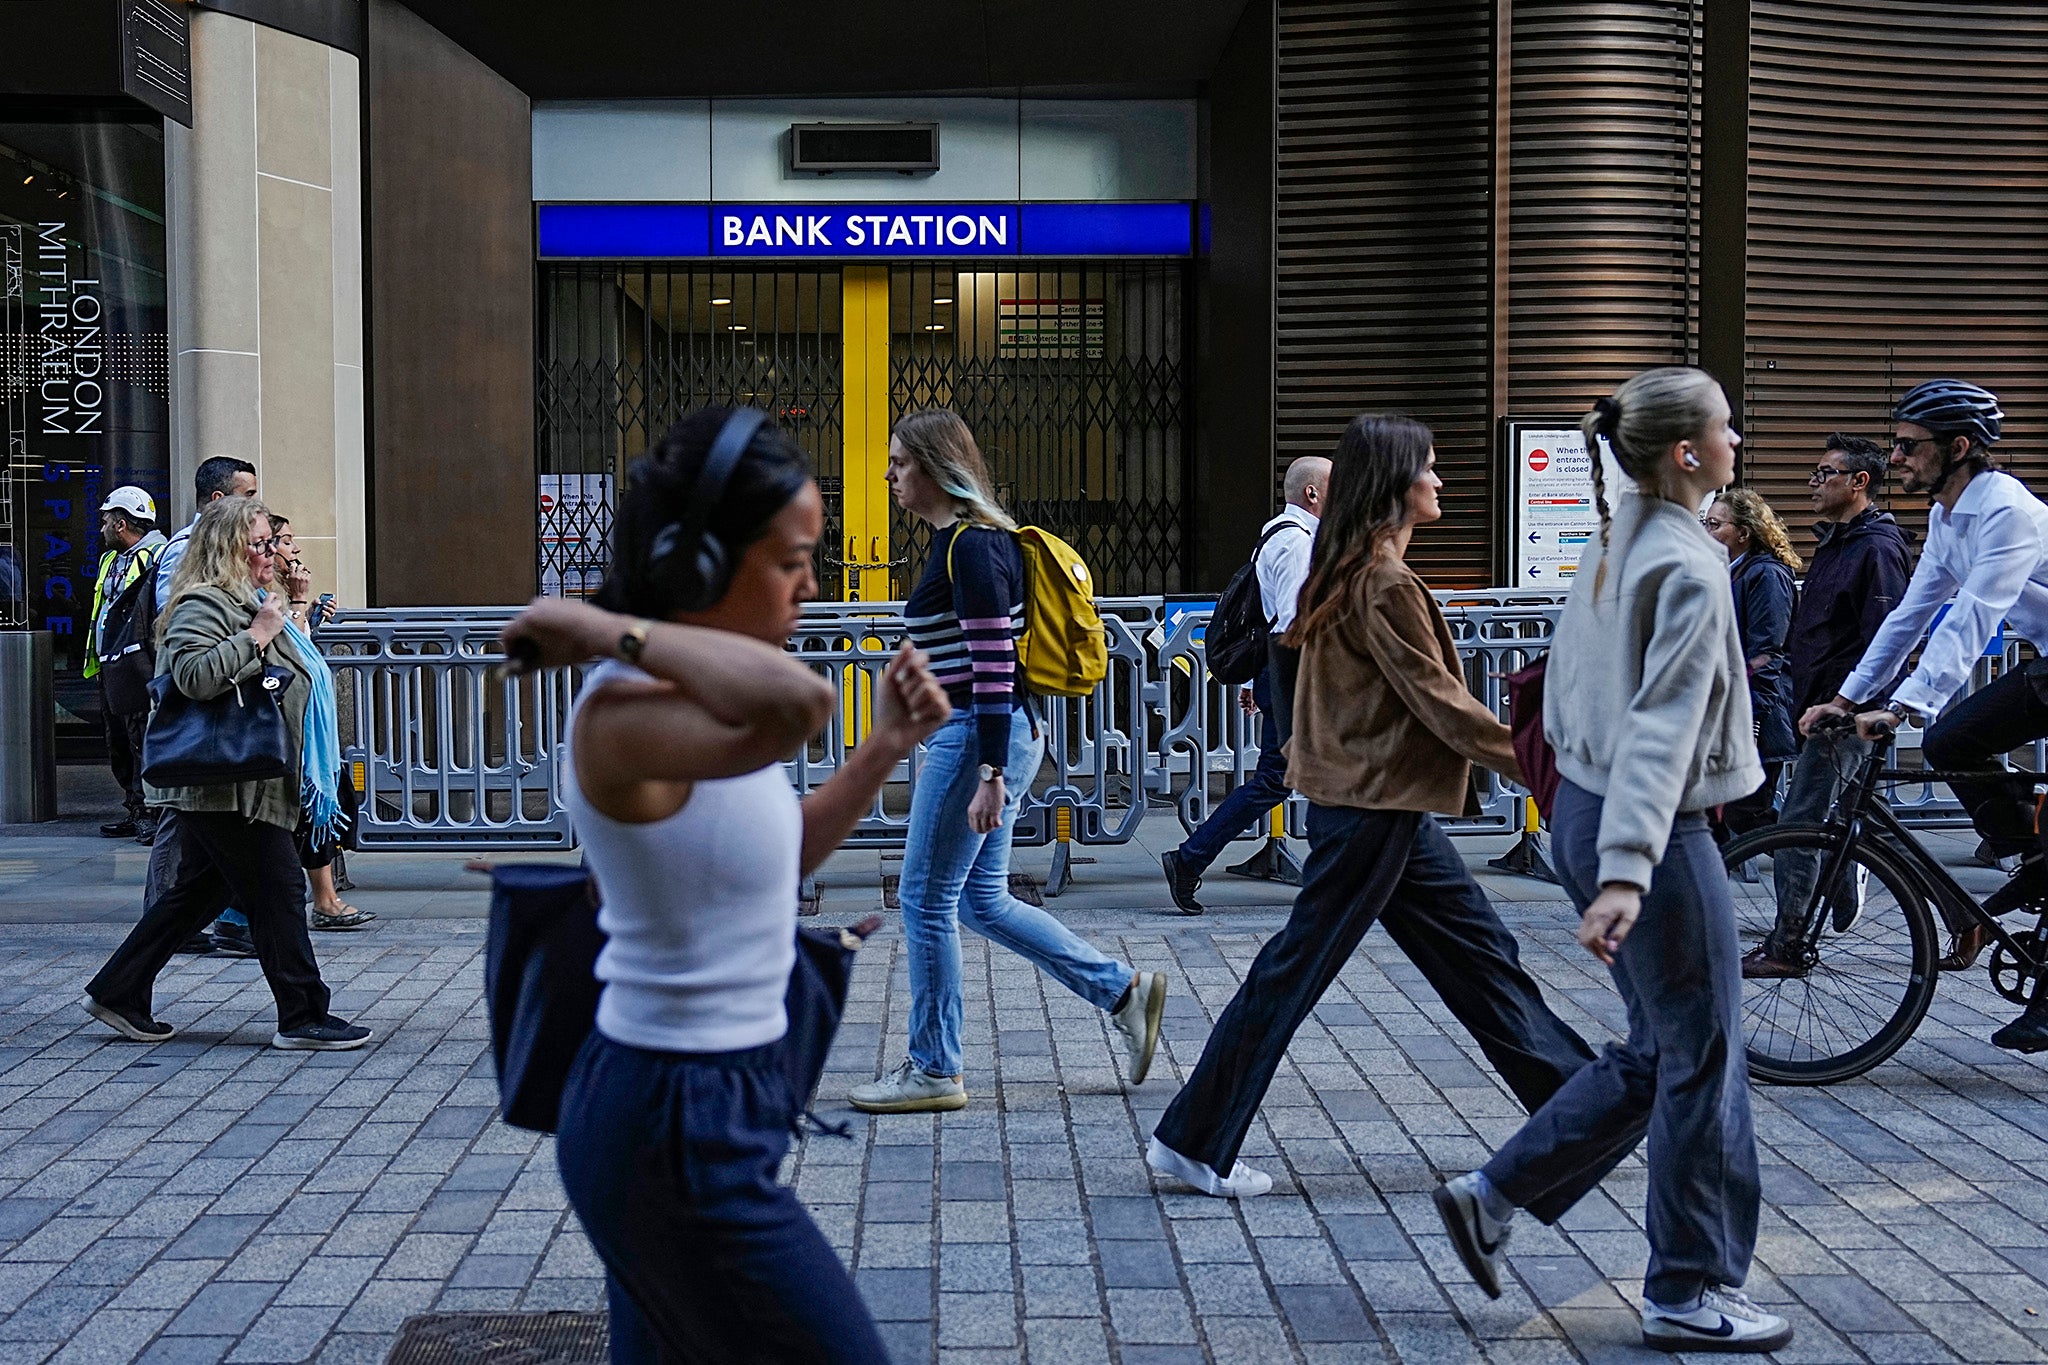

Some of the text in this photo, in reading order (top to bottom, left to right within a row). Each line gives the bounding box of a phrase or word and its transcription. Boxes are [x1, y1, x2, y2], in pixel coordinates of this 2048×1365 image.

[723, 215, 1007, 246] BANK STATION
[38, 222, 70, 434] MITHRAEUM
[72, 279, 102, 434] LONDON
[1054, 320, 1082, 328] Norther
[1060, 305, 1082, 313] Centra
[43, 464, 73, 635] SPACE
[81, 464, 102, 578] Bloomberg
